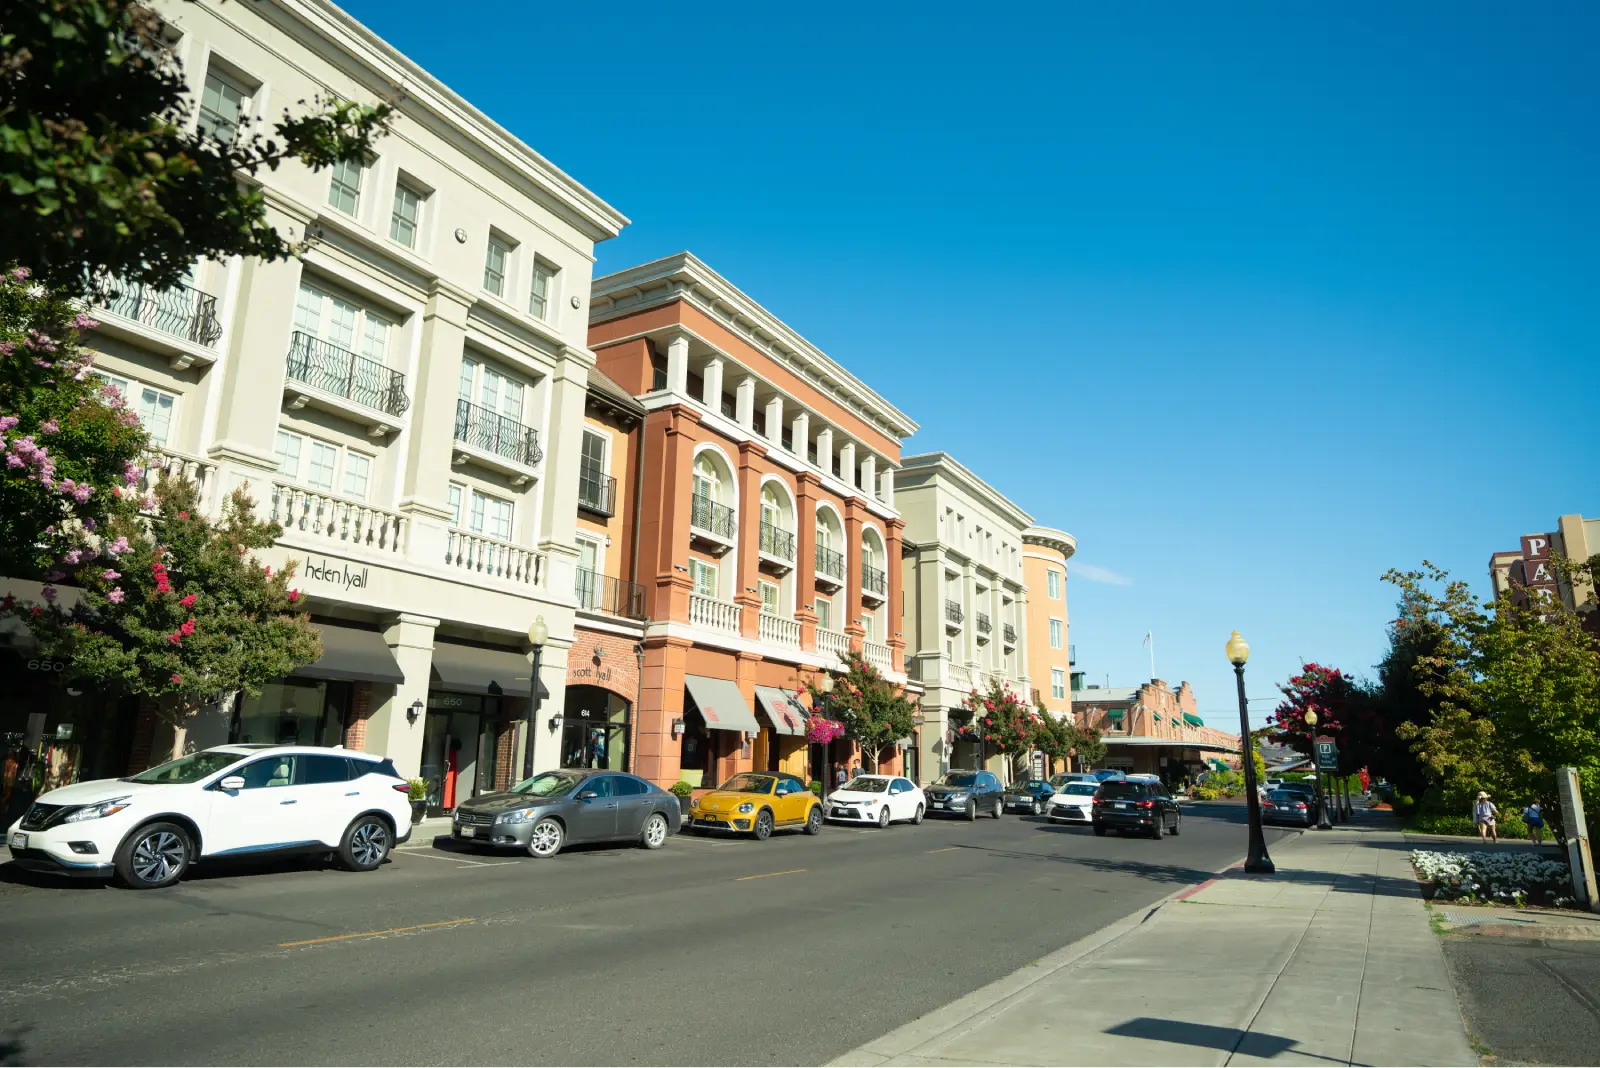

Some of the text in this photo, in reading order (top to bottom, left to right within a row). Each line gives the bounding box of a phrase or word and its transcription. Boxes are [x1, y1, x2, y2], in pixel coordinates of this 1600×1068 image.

[305, 556, 368, 591] helen lyall
[1528, 538, 1557, 623] PAR
[27, 659, 65, 672] 650
[573, 667, 612, 684] scott lyall
[443, 697, 463, 706] 650
[581, 709, 590, 717] 614
